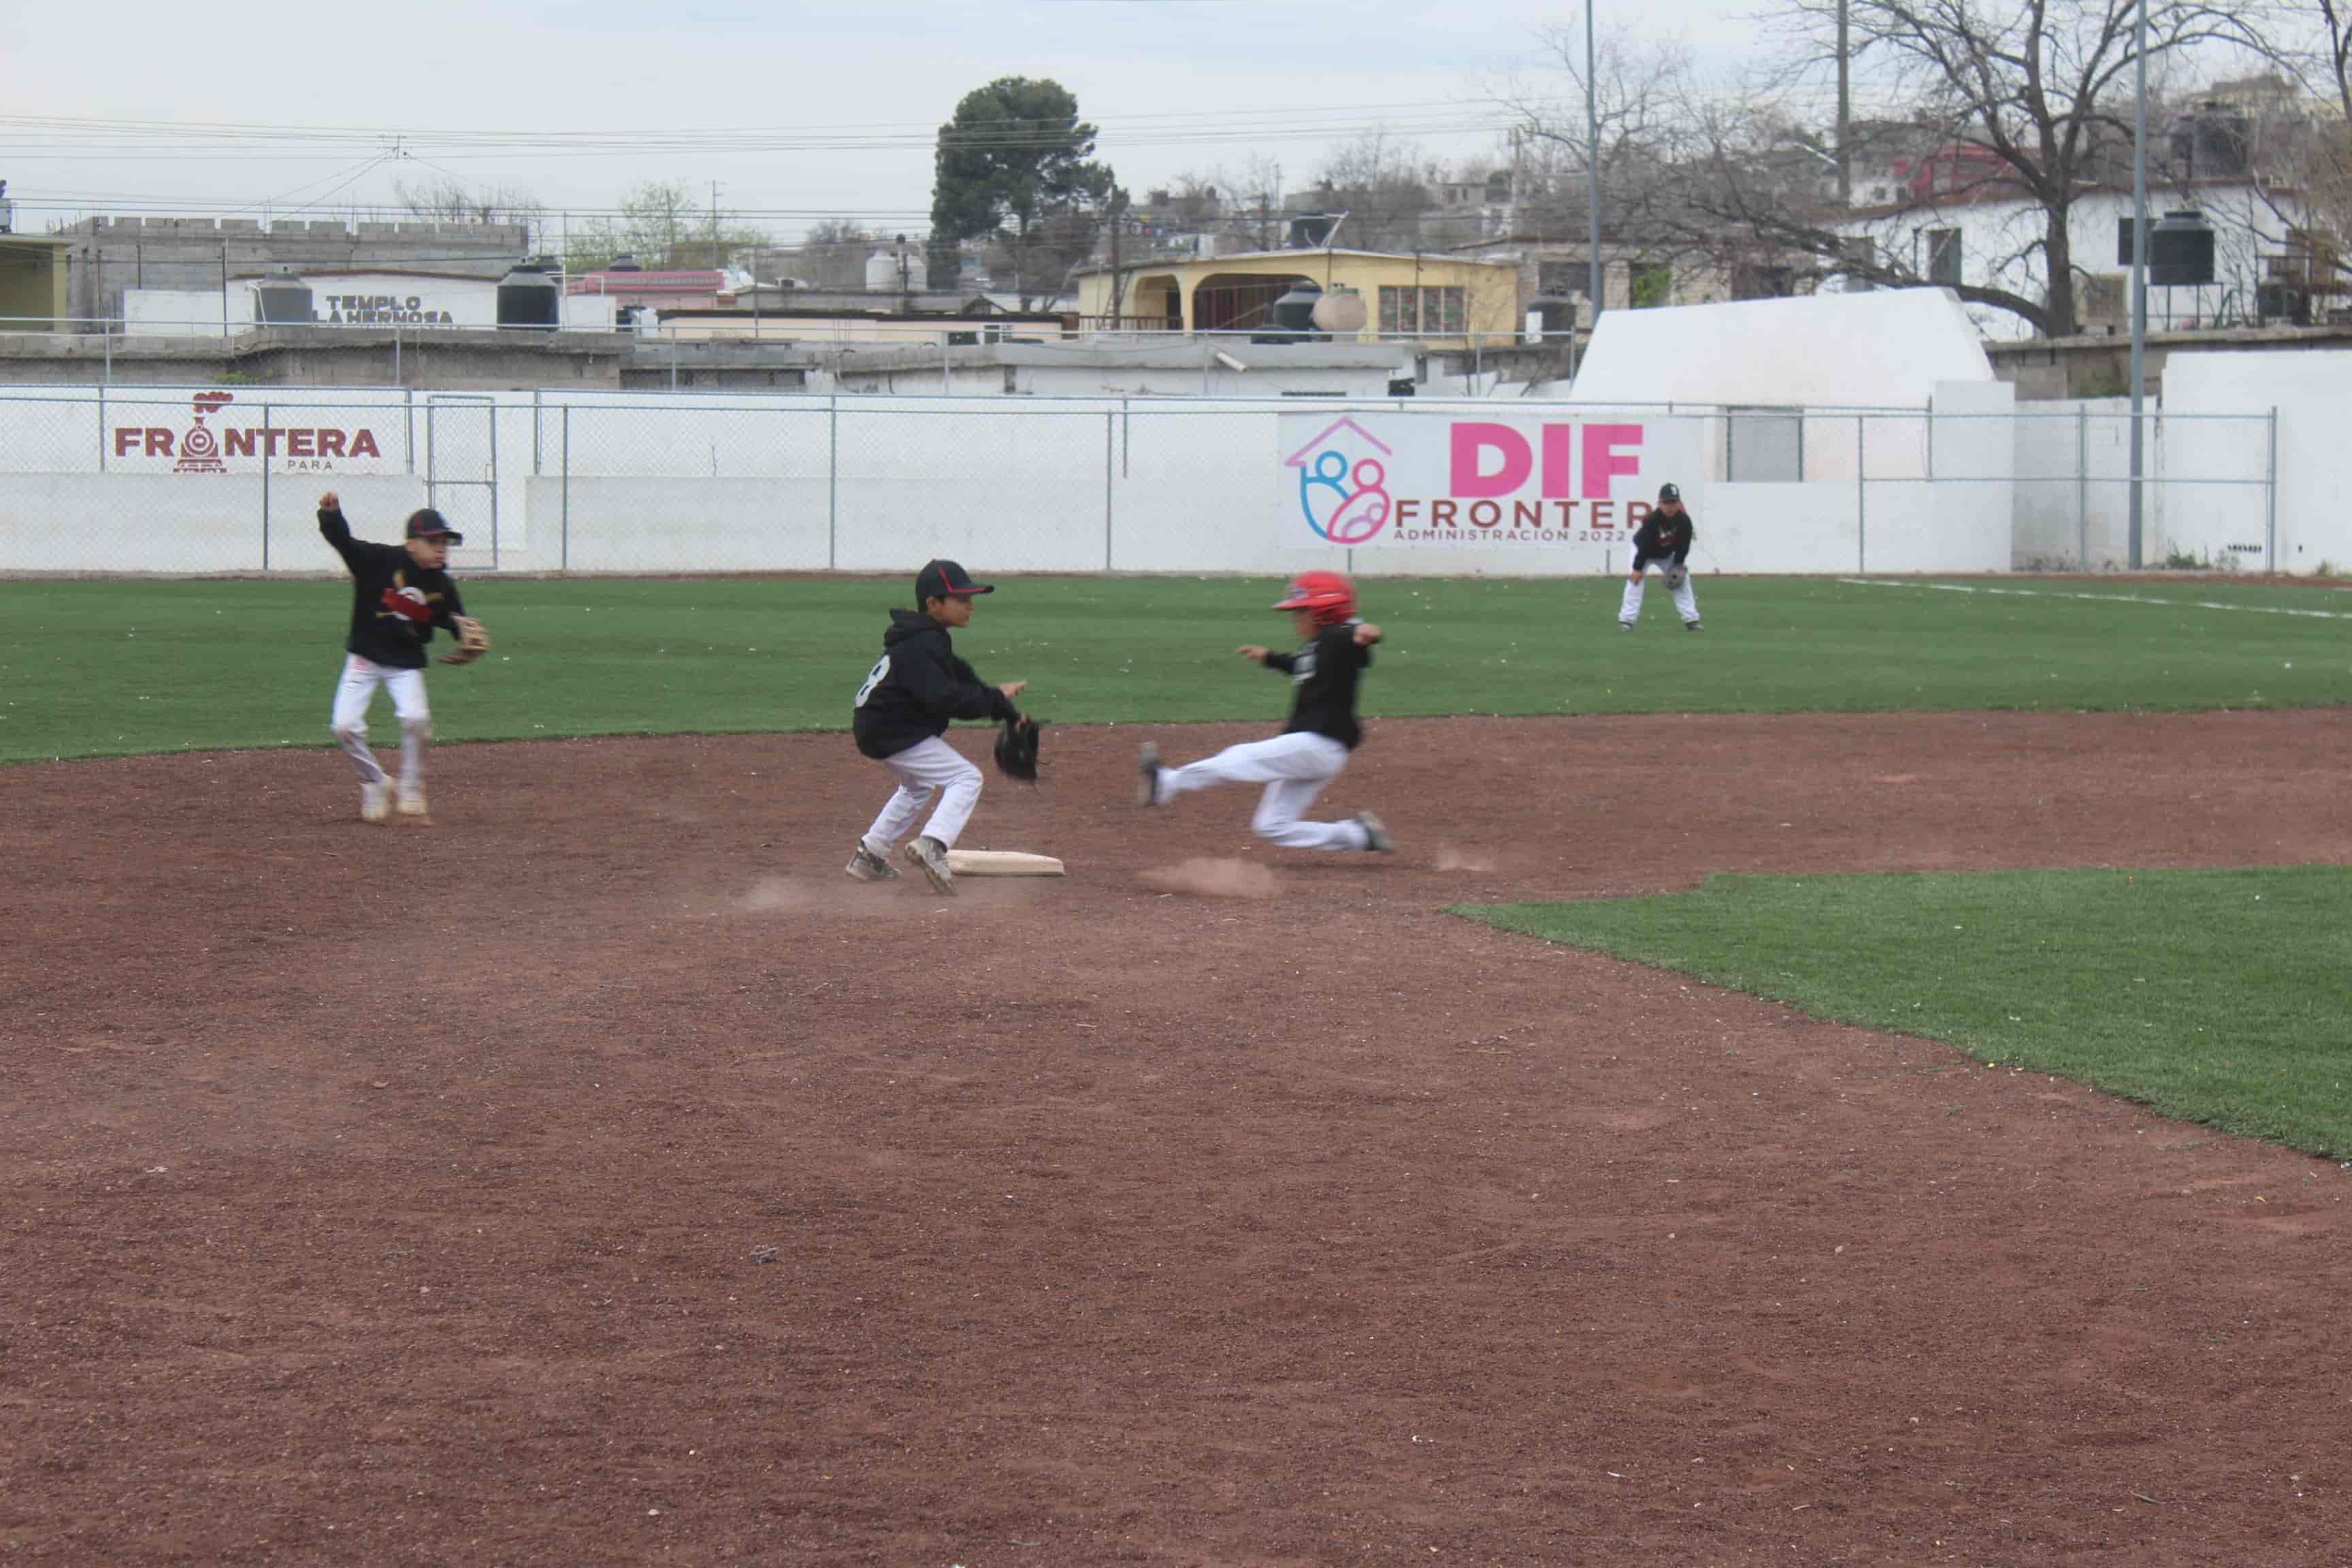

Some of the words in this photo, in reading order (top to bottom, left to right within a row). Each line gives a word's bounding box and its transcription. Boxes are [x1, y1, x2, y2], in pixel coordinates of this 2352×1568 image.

[326, 295, 421, 310] TEMPLO
[288, 460, 333, 470] PARA
[1450, 423, 1644, 498] DIF
[1396, 500, 1686, 529] FRONTER
[1394, 528, 1569, 541] ADMINISTRACIÓN
